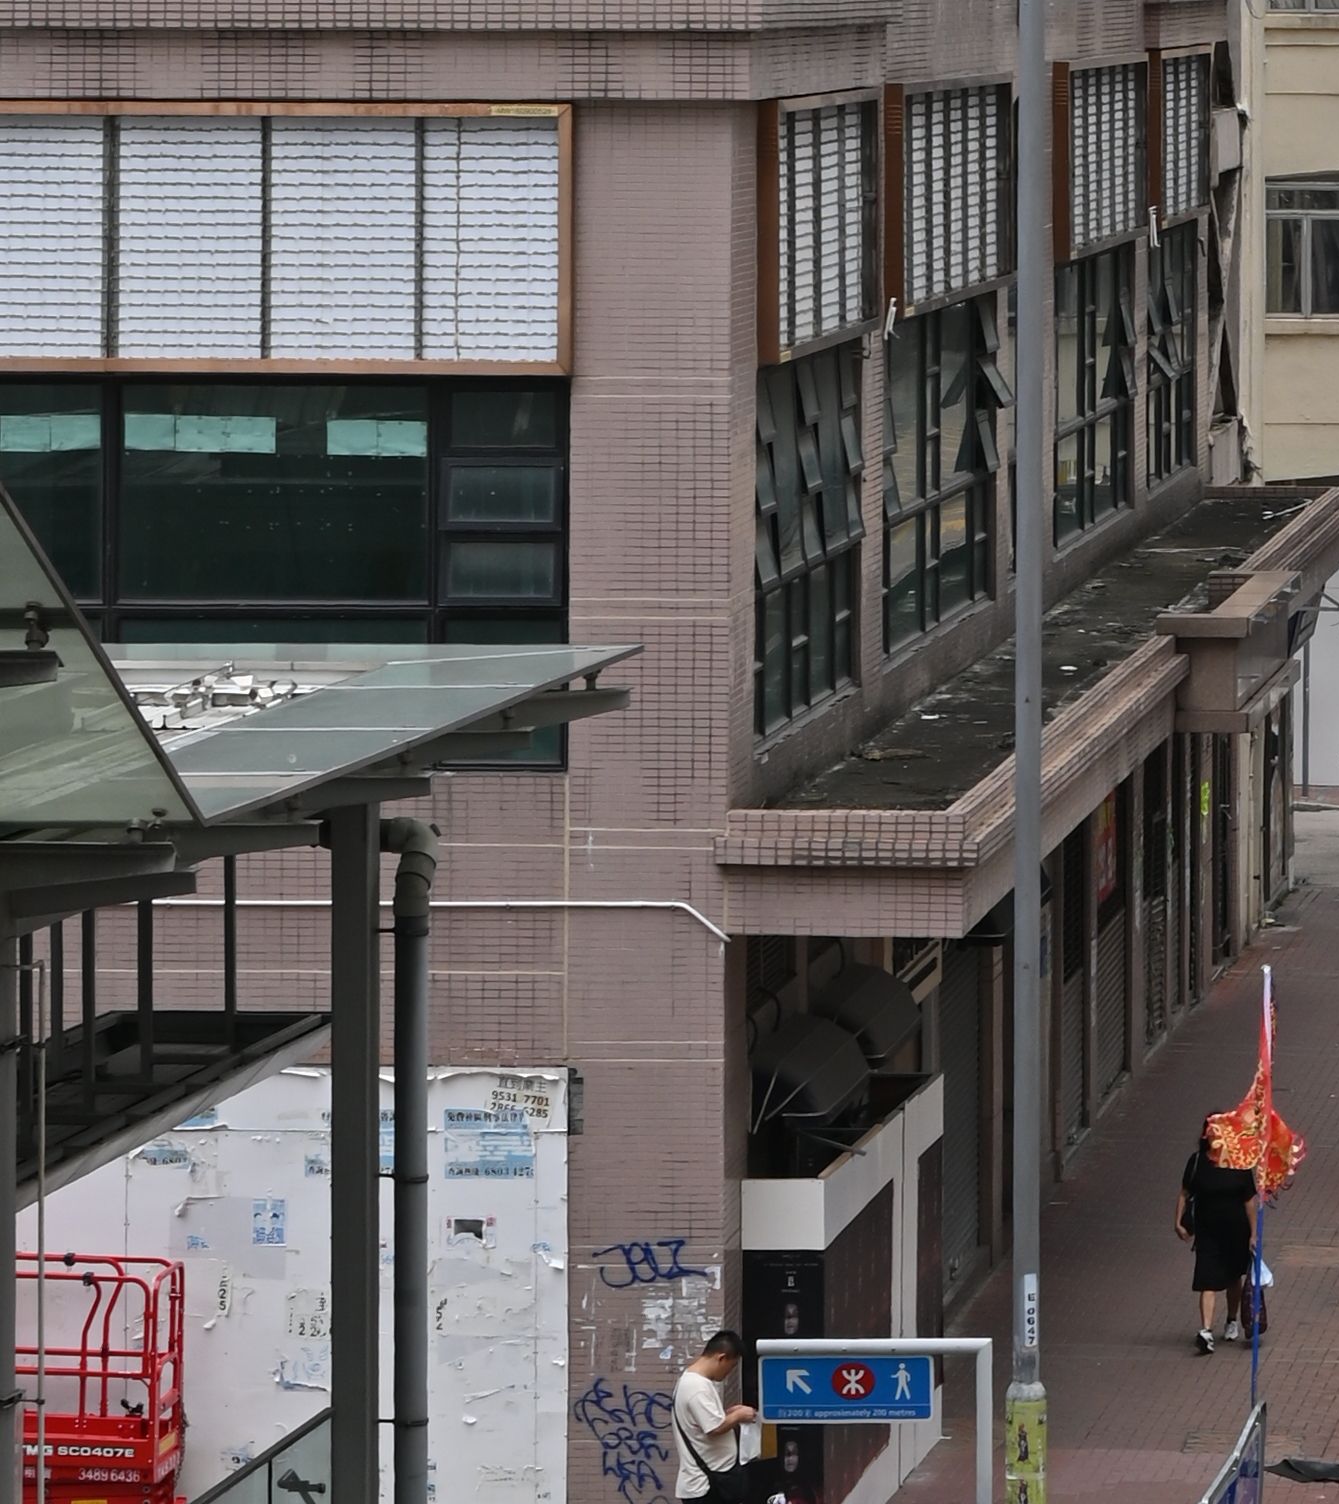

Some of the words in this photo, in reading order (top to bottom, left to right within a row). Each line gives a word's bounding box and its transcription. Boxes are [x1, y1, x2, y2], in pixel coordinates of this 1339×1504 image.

[491, 1090, 518, 1102] 9531
[523, 1094, 550, 1107] 7701
[814, 1408, 872, 1418] approximately
[872, 1409, 887, 1417] 200
[78, 1468, 109, 1482] 3489
[110, 1469, 140, 1483] 6436
